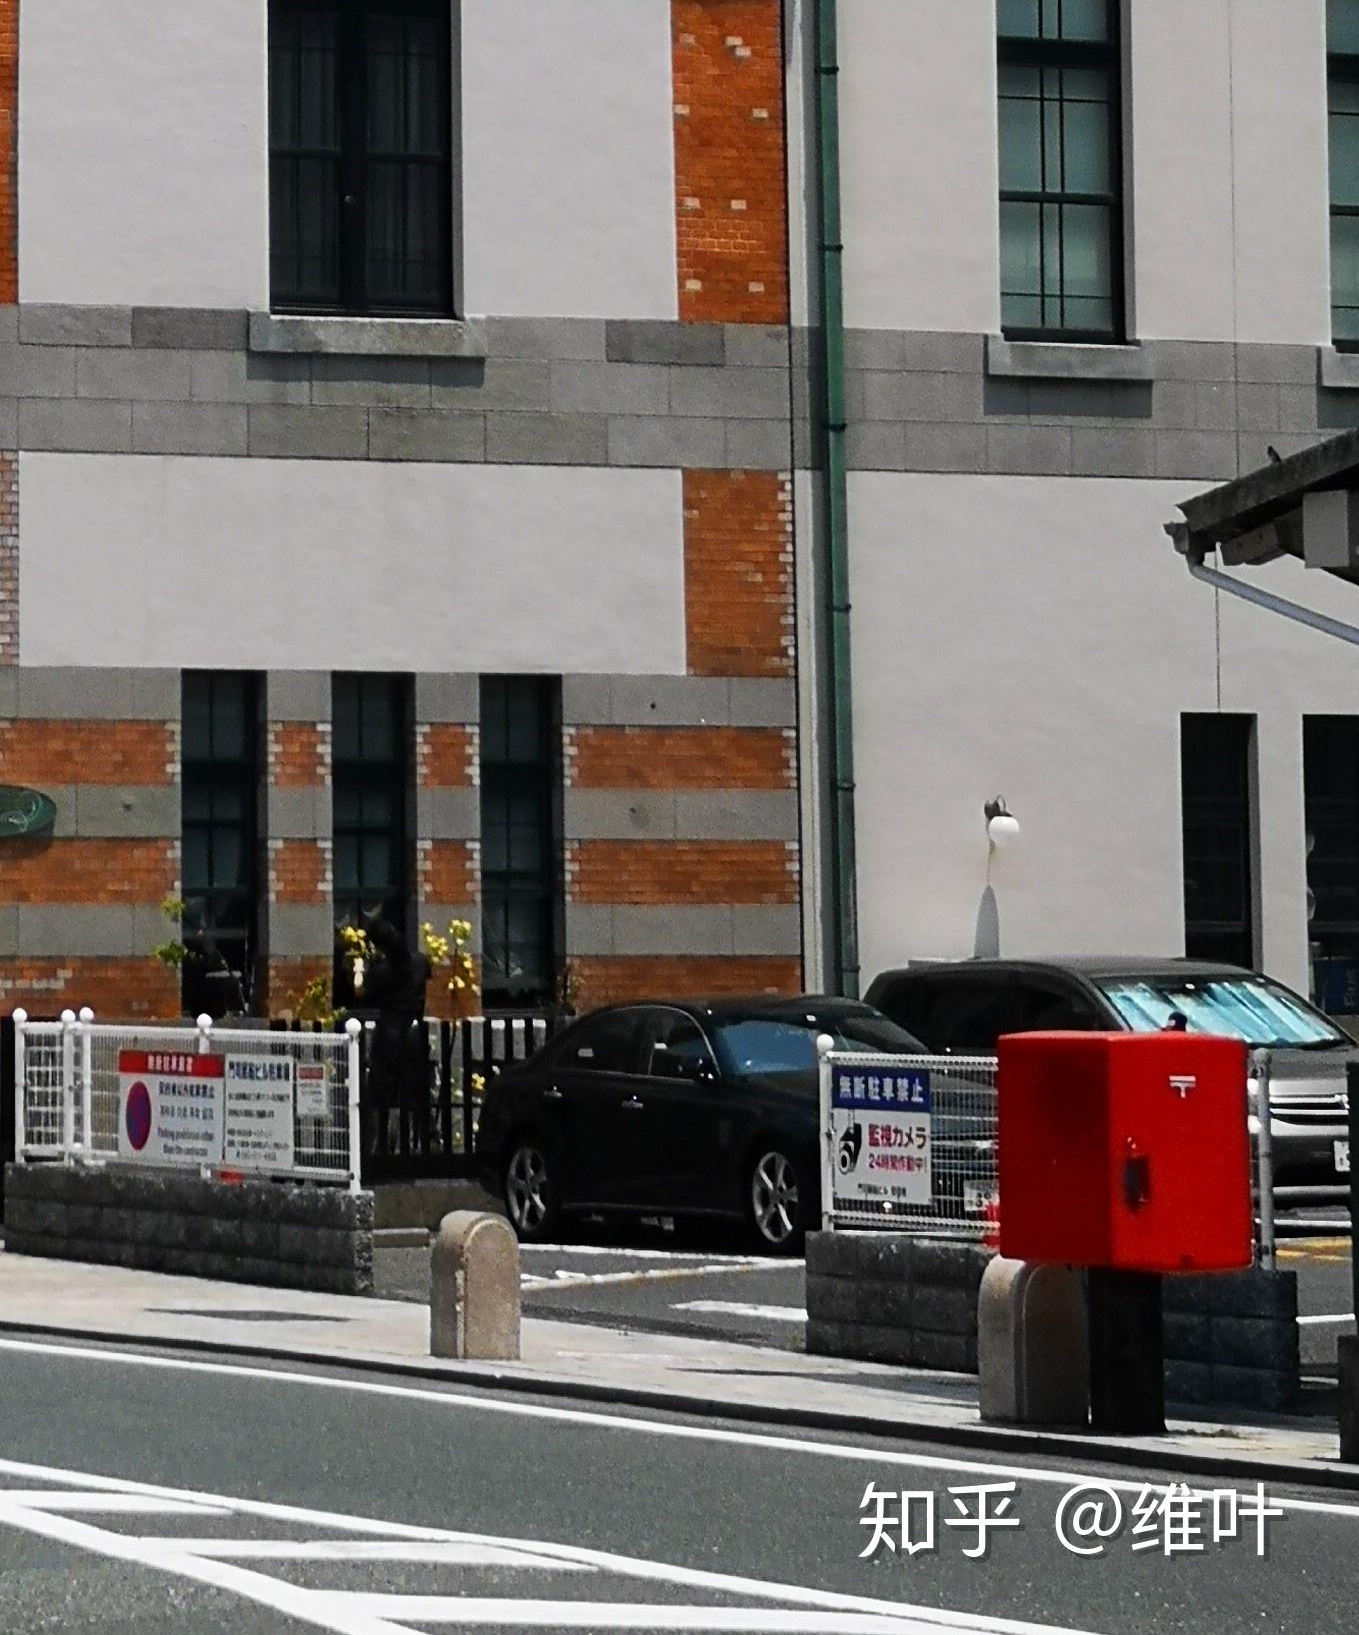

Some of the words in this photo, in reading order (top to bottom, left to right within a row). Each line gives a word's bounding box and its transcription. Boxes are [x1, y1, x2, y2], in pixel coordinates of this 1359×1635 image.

[839, 1075, 924, 1103] 無断駐車禁止
[868, 1122, 927, 1150] 監視カメラ
